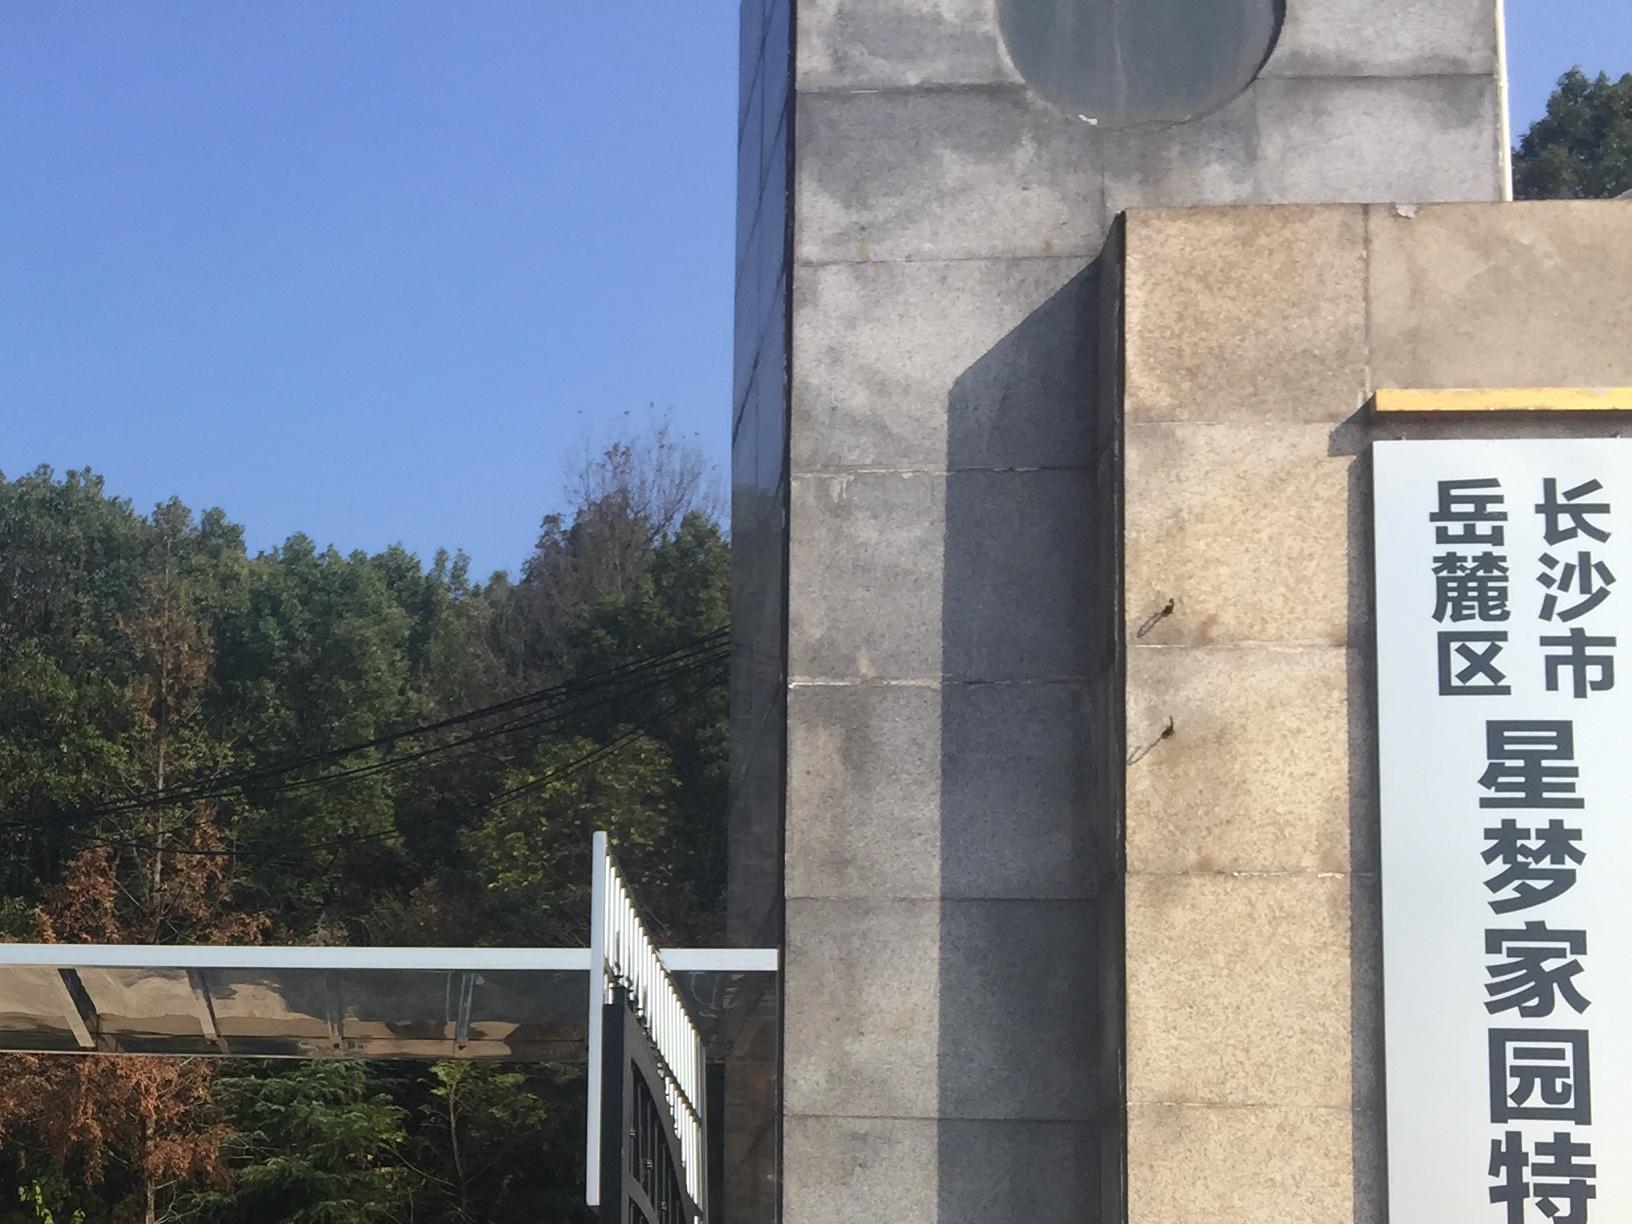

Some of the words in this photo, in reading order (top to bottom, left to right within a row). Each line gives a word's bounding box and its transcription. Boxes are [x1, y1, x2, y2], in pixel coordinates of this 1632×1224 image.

[1429, 477, 1512, 697] 岳麓区
[1534, 477, 1617, 699] 长沙市
